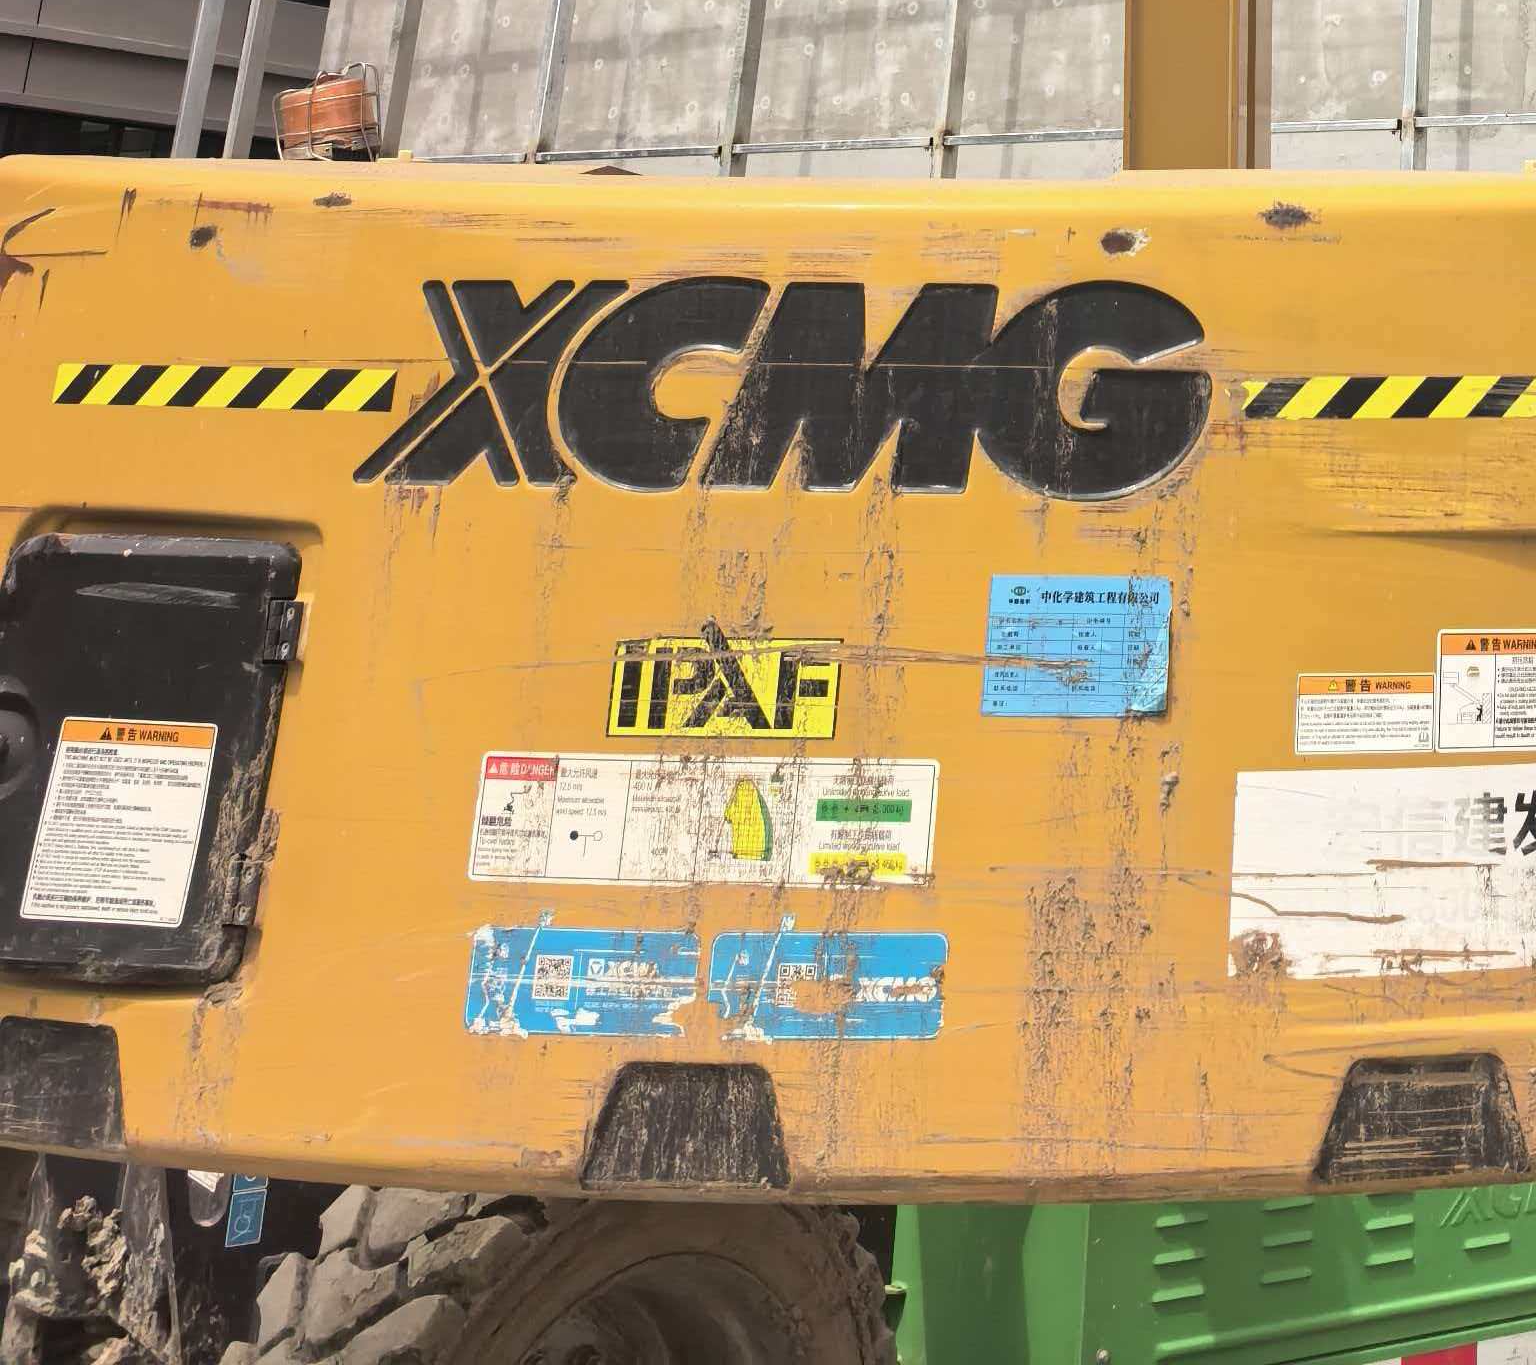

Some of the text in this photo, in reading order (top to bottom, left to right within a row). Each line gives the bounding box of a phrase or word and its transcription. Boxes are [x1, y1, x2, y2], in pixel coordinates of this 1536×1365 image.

[354, 275, 1213, 501] XCMG
[617, 621, 832, 729] IPAF
[1375, 680, 1412, 690] WARNING
[139, 730, 180, 742] WARNING
[856, 976, 938, 1002] XCMG
